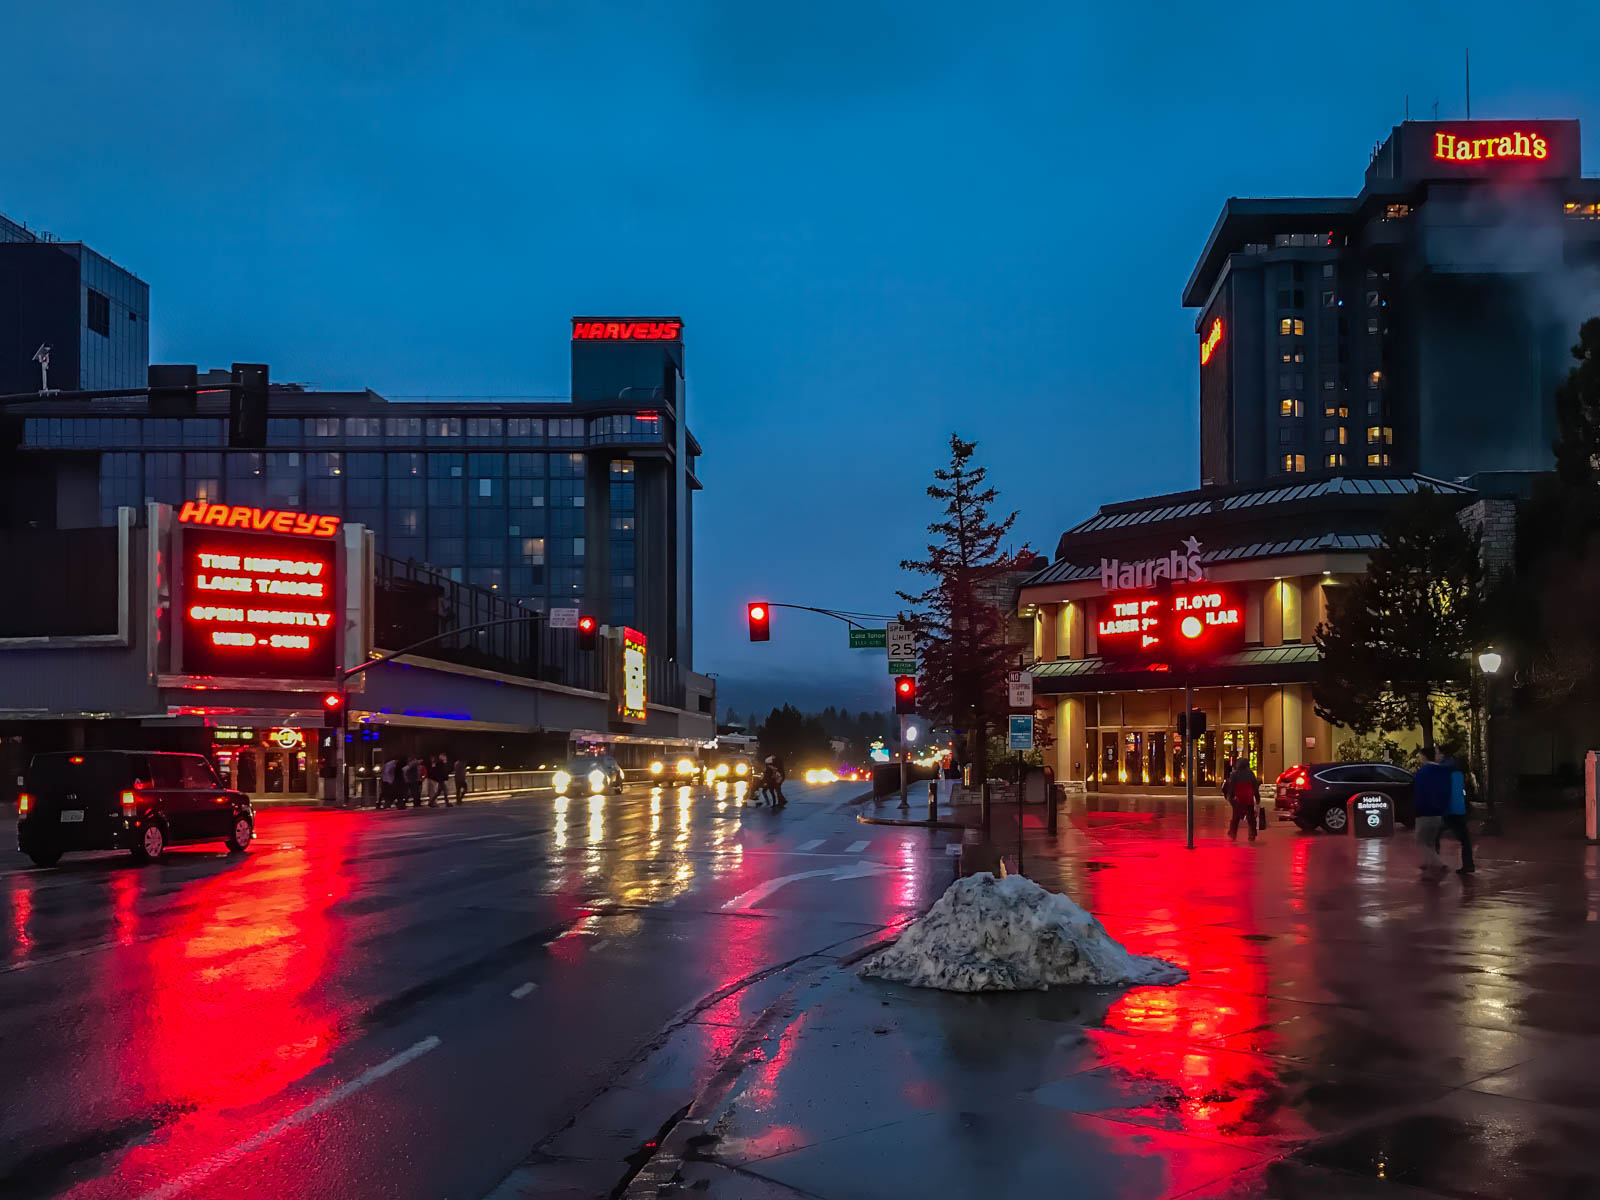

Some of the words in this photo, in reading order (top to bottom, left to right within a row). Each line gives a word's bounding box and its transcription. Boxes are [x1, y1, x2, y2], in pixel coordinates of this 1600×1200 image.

[1435, 132, 1547, 160] Harrah's
[573, 322, 680, 339] HARVEYS
[178, 501, 341, 537] HARVEYS
[198, 553, 241, 570] THE
[197, 574, 253, 593] LAKE
[255, 578, 323, 598] TAHOE
[190, 605, 244, 622] OPEN
[246, 608, 331, 627] NIGHTLY
[1099, 619, 1140, 635] LASER
[891, 643, 913, 656] 25
[1010, 672, 1019, 682] NO
